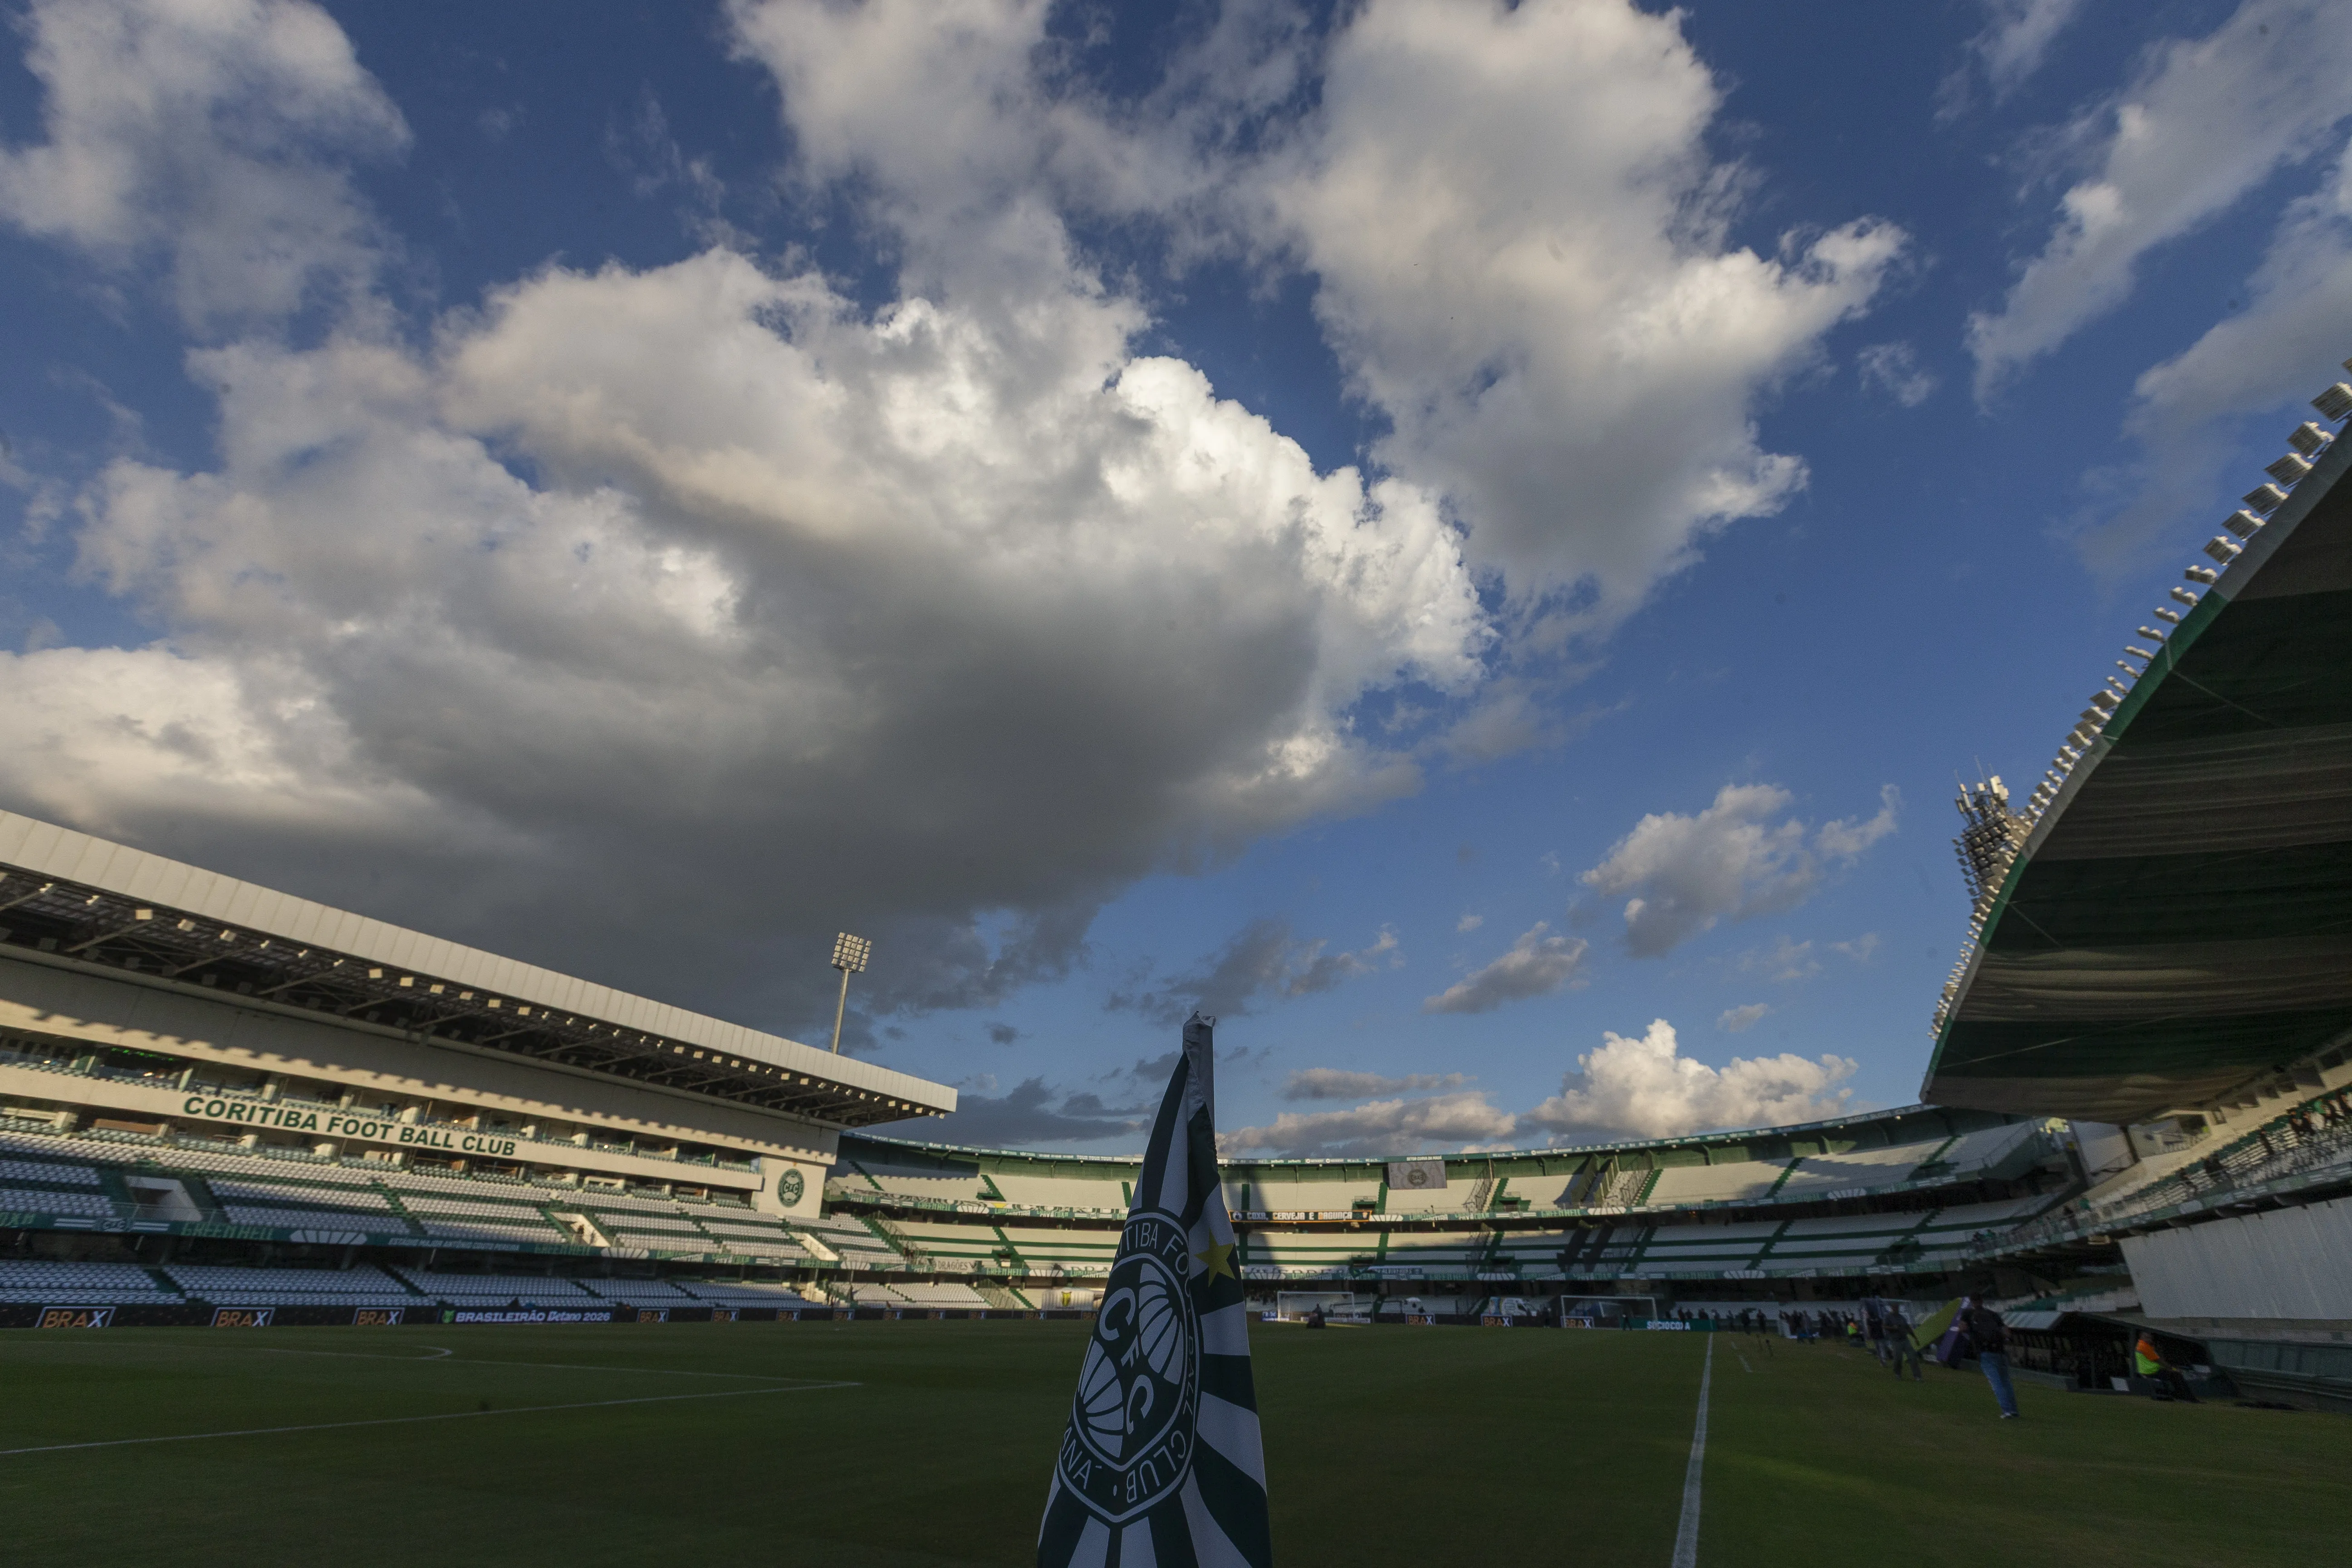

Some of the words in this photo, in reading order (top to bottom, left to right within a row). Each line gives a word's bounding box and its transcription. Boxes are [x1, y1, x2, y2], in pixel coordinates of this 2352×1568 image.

[184, 1097, 317, 1130] CORITIBA
[327, 1117, 393, 1140] FOOT
[399, 1127, 453, 1148] BALL
[462, 1136, 515, 1156] CLUB
[1273, 1212, 1305, 1220] CERVEJA
[1117, 1223, 1158, 1259] ITIBA
[42, 1311, 108, 1328] BRAX
[216, 1311, 269, 1327] BRAX
[357, 1311, 400, 1325] BRAX
[455, 1310, 545, 1322] BRASILEIRÃO
[547, 1310, 581, 1322] Betano
[583, 1312, 611, 1322] 2026
[640, 1311, 666, 1322] BRAX
[1083, 1312, 1099, 1320] BRA
[1408, 1316, 1433, 1325] BRAX
[1484, 1317, 1510, 1327] BRAX
[1062, 1421, 1102, 1490] ANÁ
[1127, 1430, 1186, 1503] CLUB
